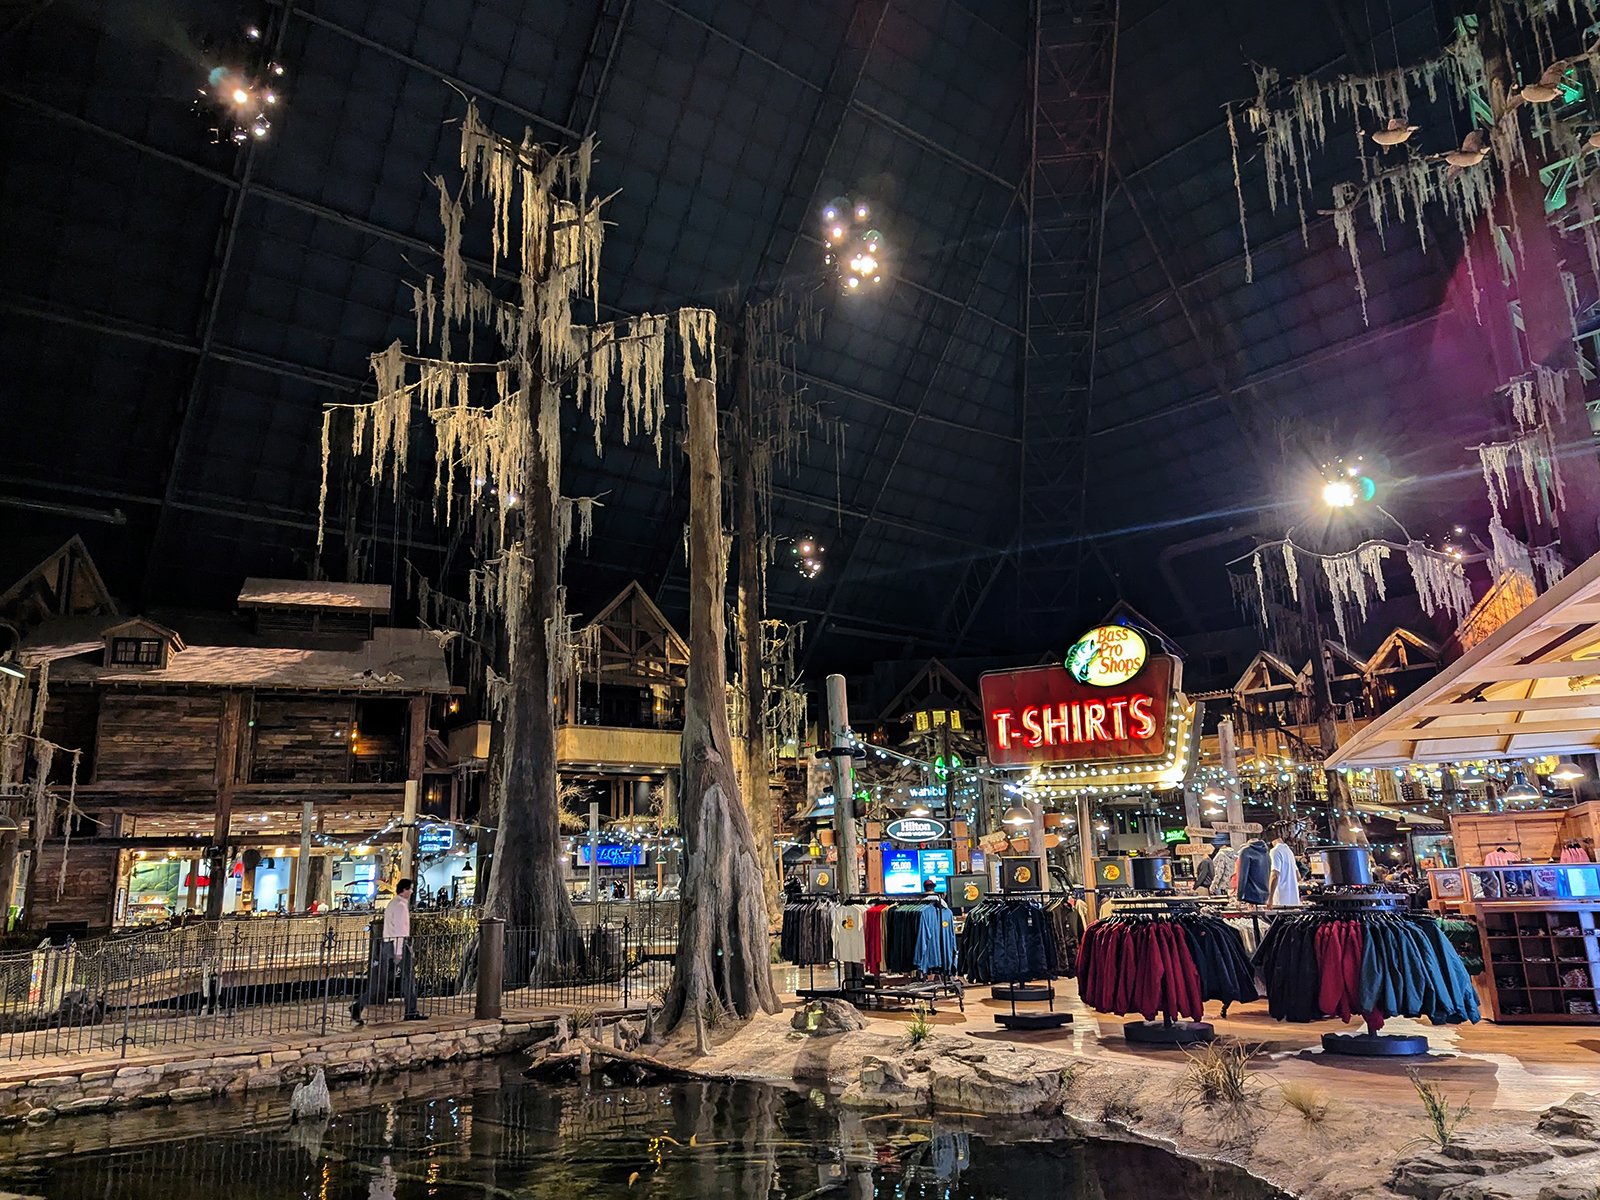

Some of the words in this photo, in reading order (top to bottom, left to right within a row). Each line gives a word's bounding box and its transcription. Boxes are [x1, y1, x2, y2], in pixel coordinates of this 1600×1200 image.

[1097, 627, 1129, 644] Bass
[1098, 643, 1123, 658] Pro
[1098, 656, 1141, 676] Shops
[992, 693, 1157, 750] T-SHIRTS
[900, 821, 931, 831] Hilton
